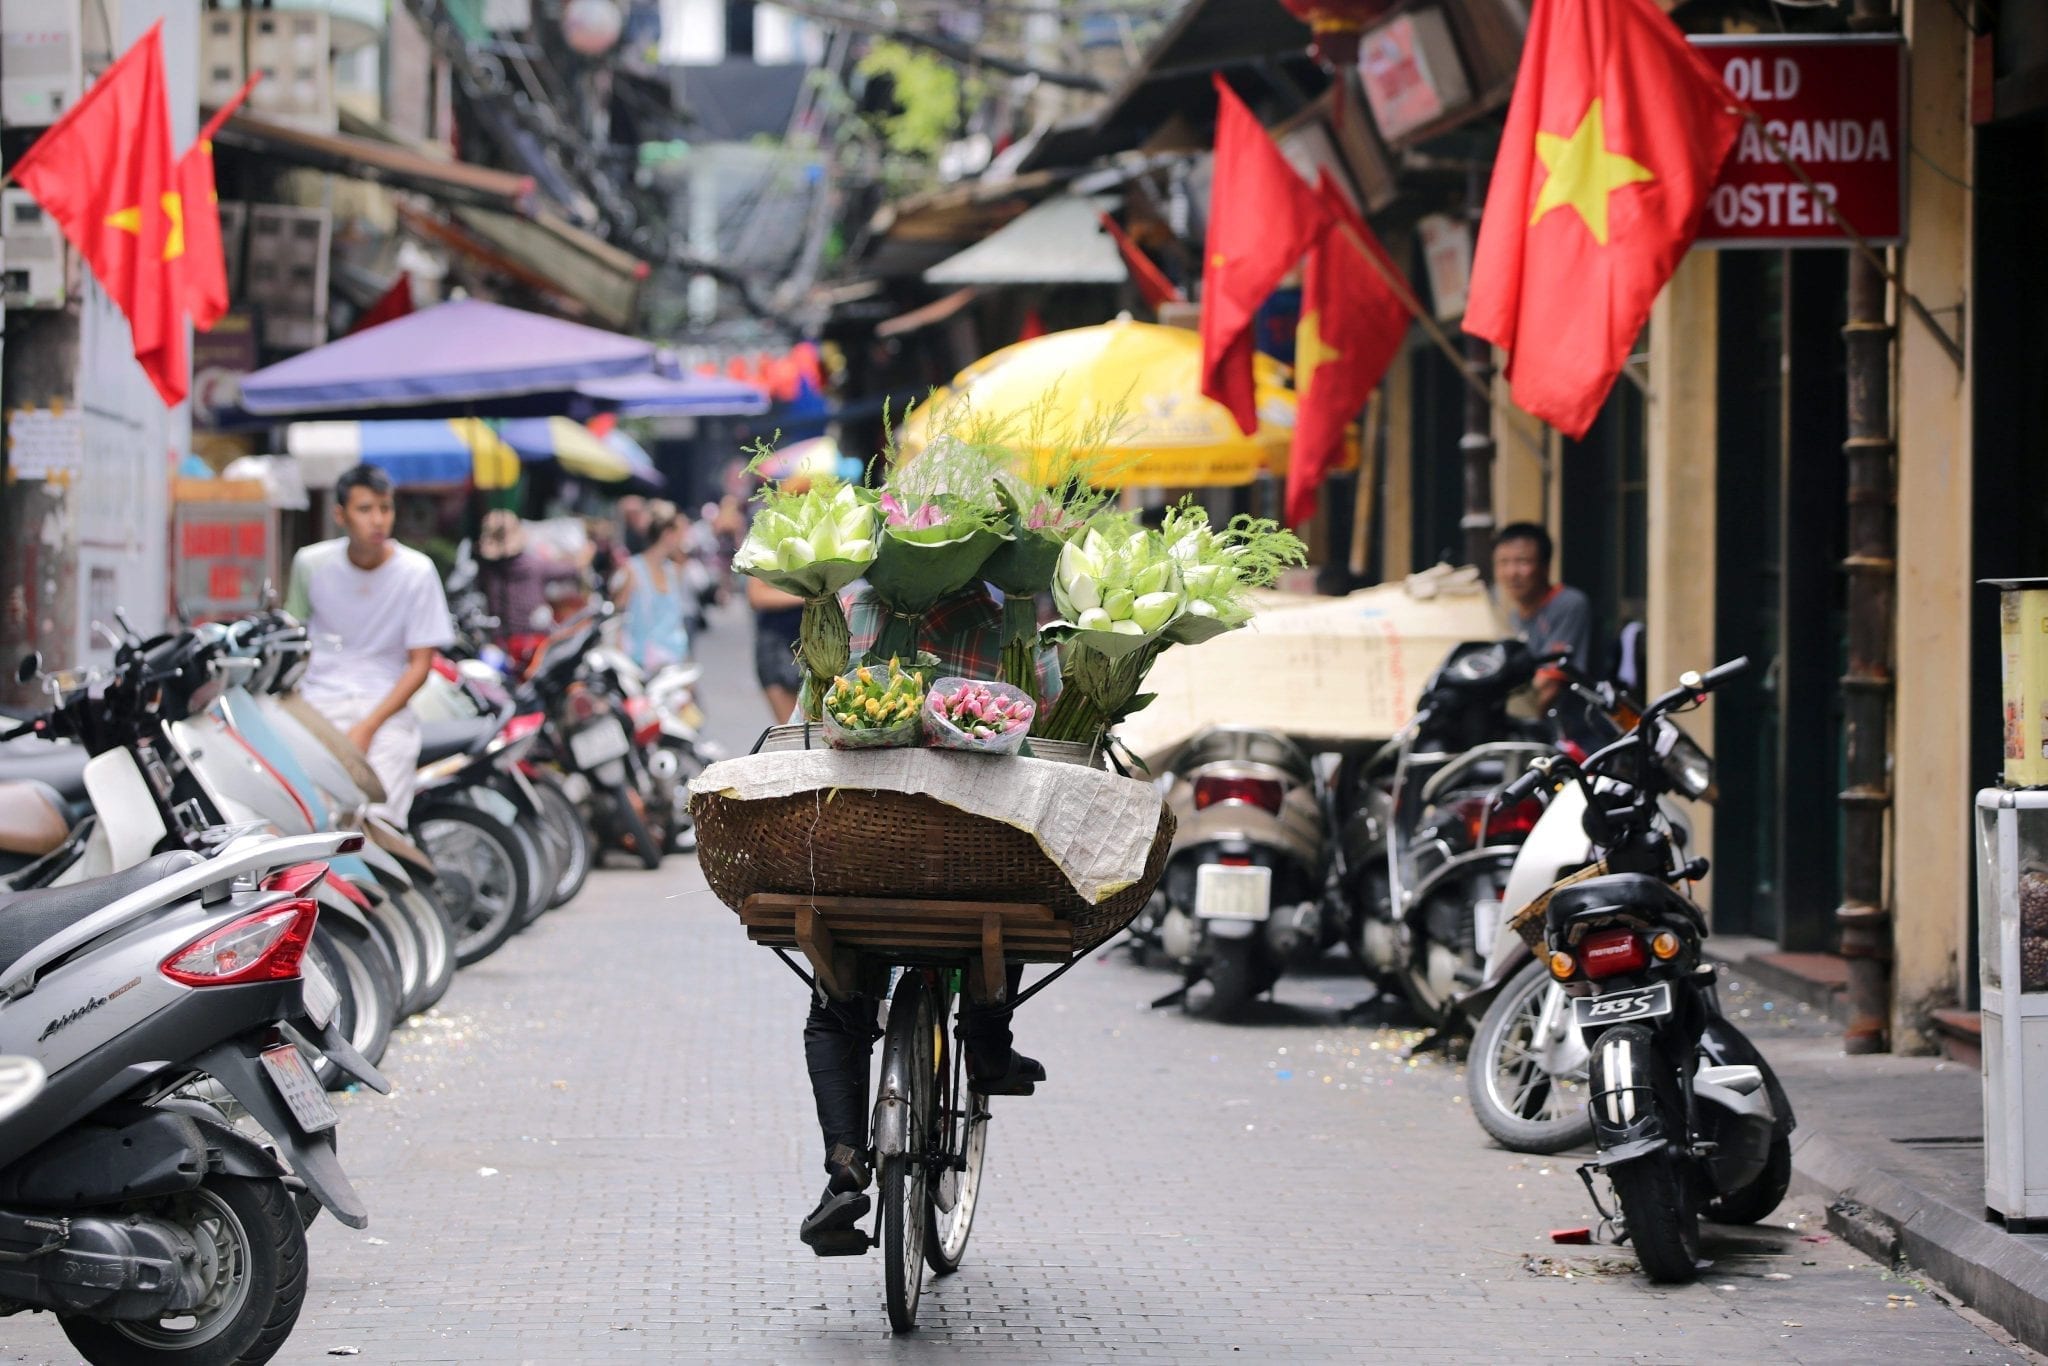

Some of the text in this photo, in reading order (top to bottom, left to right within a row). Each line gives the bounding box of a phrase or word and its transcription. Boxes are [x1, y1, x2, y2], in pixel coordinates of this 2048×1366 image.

[1723, 57, 1799, 101] OLD
[1737, 119, 1891, 164] AGANDA
[1707, 183, 1838, 227] OSTER
